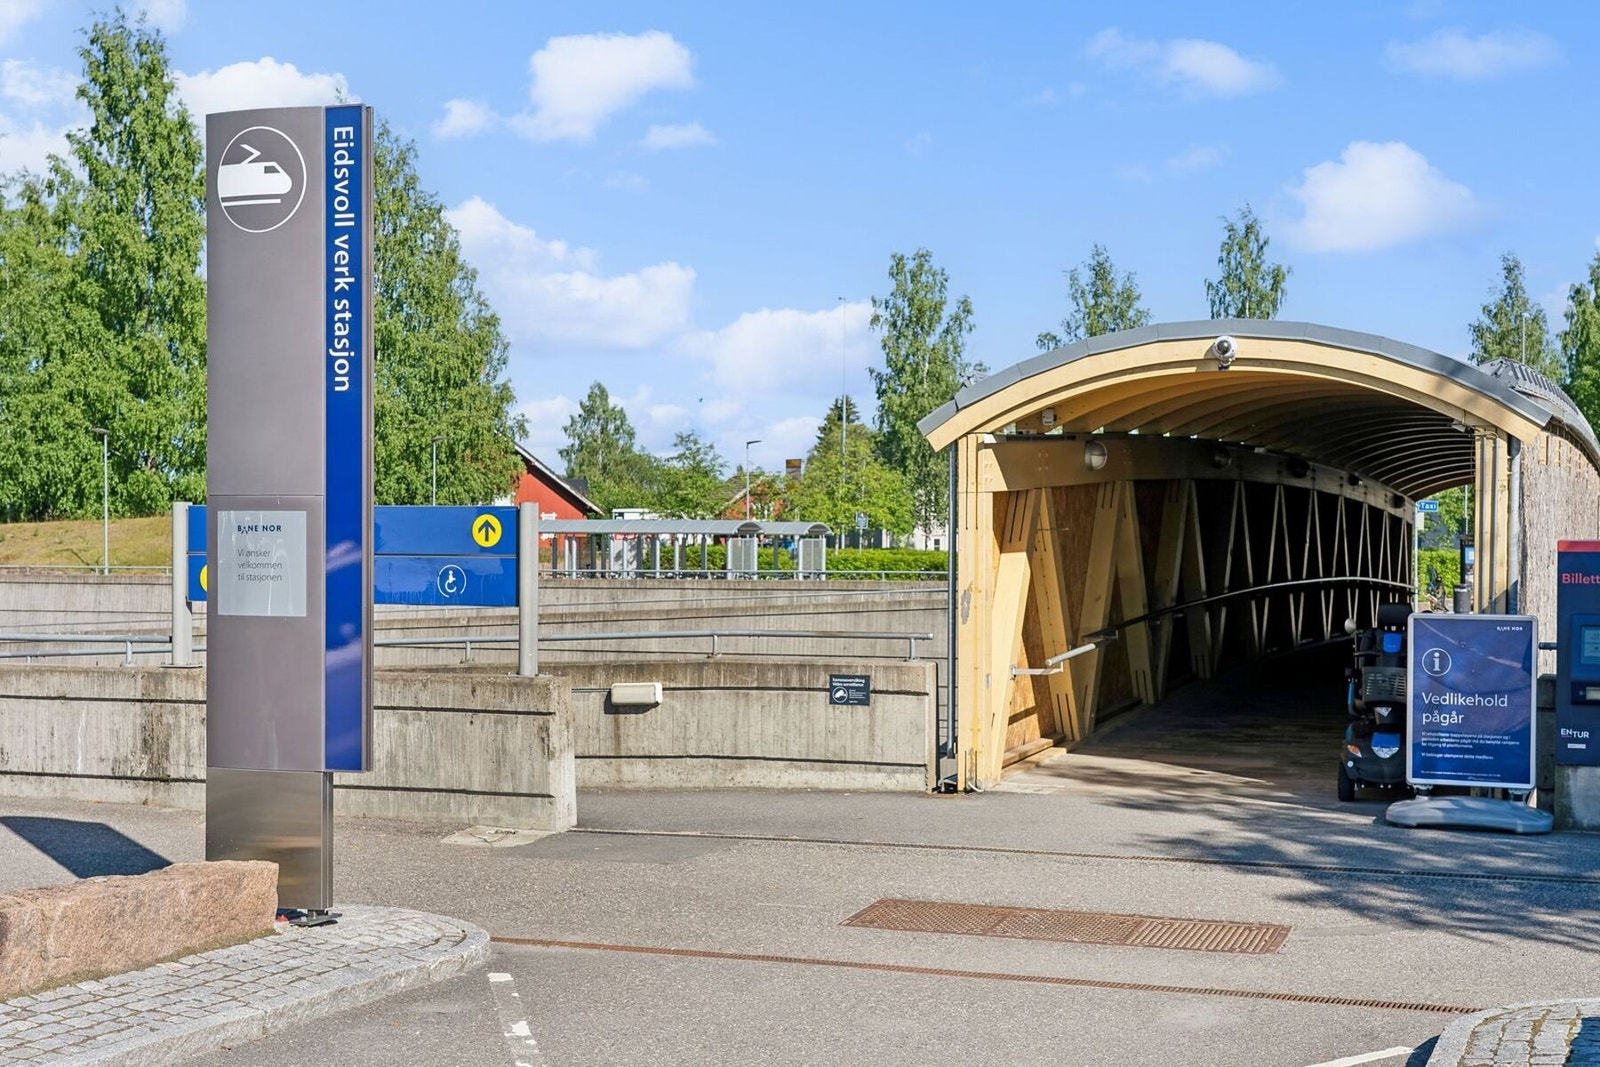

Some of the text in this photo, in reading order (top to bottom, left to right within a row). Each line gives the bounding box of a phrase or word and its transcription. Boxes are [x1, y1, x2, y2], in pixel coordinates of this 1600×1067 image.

[329, 126, 355, 392] Eidsvoll verk stasjon
[1420, 502, 1437, 510] Taxi
[262, 524, 282, 532] NOR
[237, 549, 271, 558] Vi ønsker
[237, 560, 283, 569] velkommen
[245, 573, 283, 584] stasjonen
[1421, 691, 1508, 707] Vedlikehold
[1421, 709, 1465, 726] pågår
[1560, 728, 1590, 739] ENTUR
